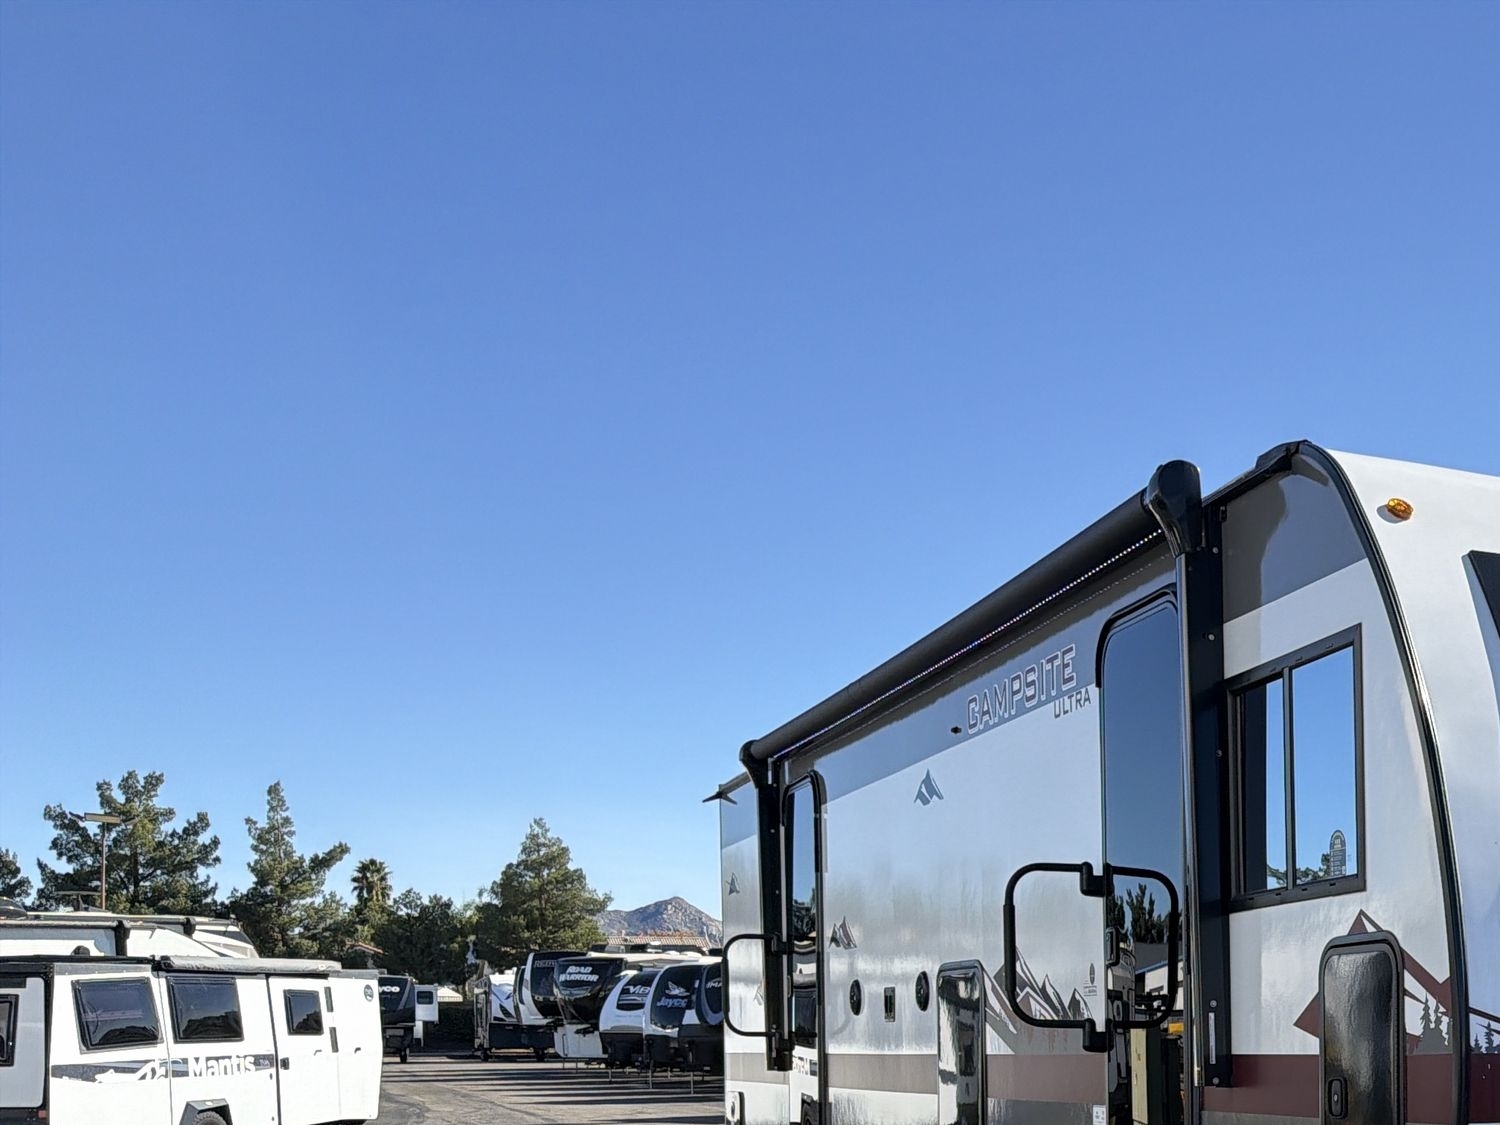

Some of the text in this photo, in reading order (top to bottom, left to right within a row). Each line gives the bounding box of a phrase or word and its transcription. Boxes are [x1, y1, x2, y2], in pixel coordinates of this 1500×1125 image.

[967, 643, 1076, 734] CAMPSITE
[1053, 687, 1092, 719] ULTRA
[559, 973, 599, 982] WARRIOR
[566, 965, 593, 974] ROAD
[656, 997, 688, 1008] Jayco
[189, 1055, 256, 1077] Mantis
